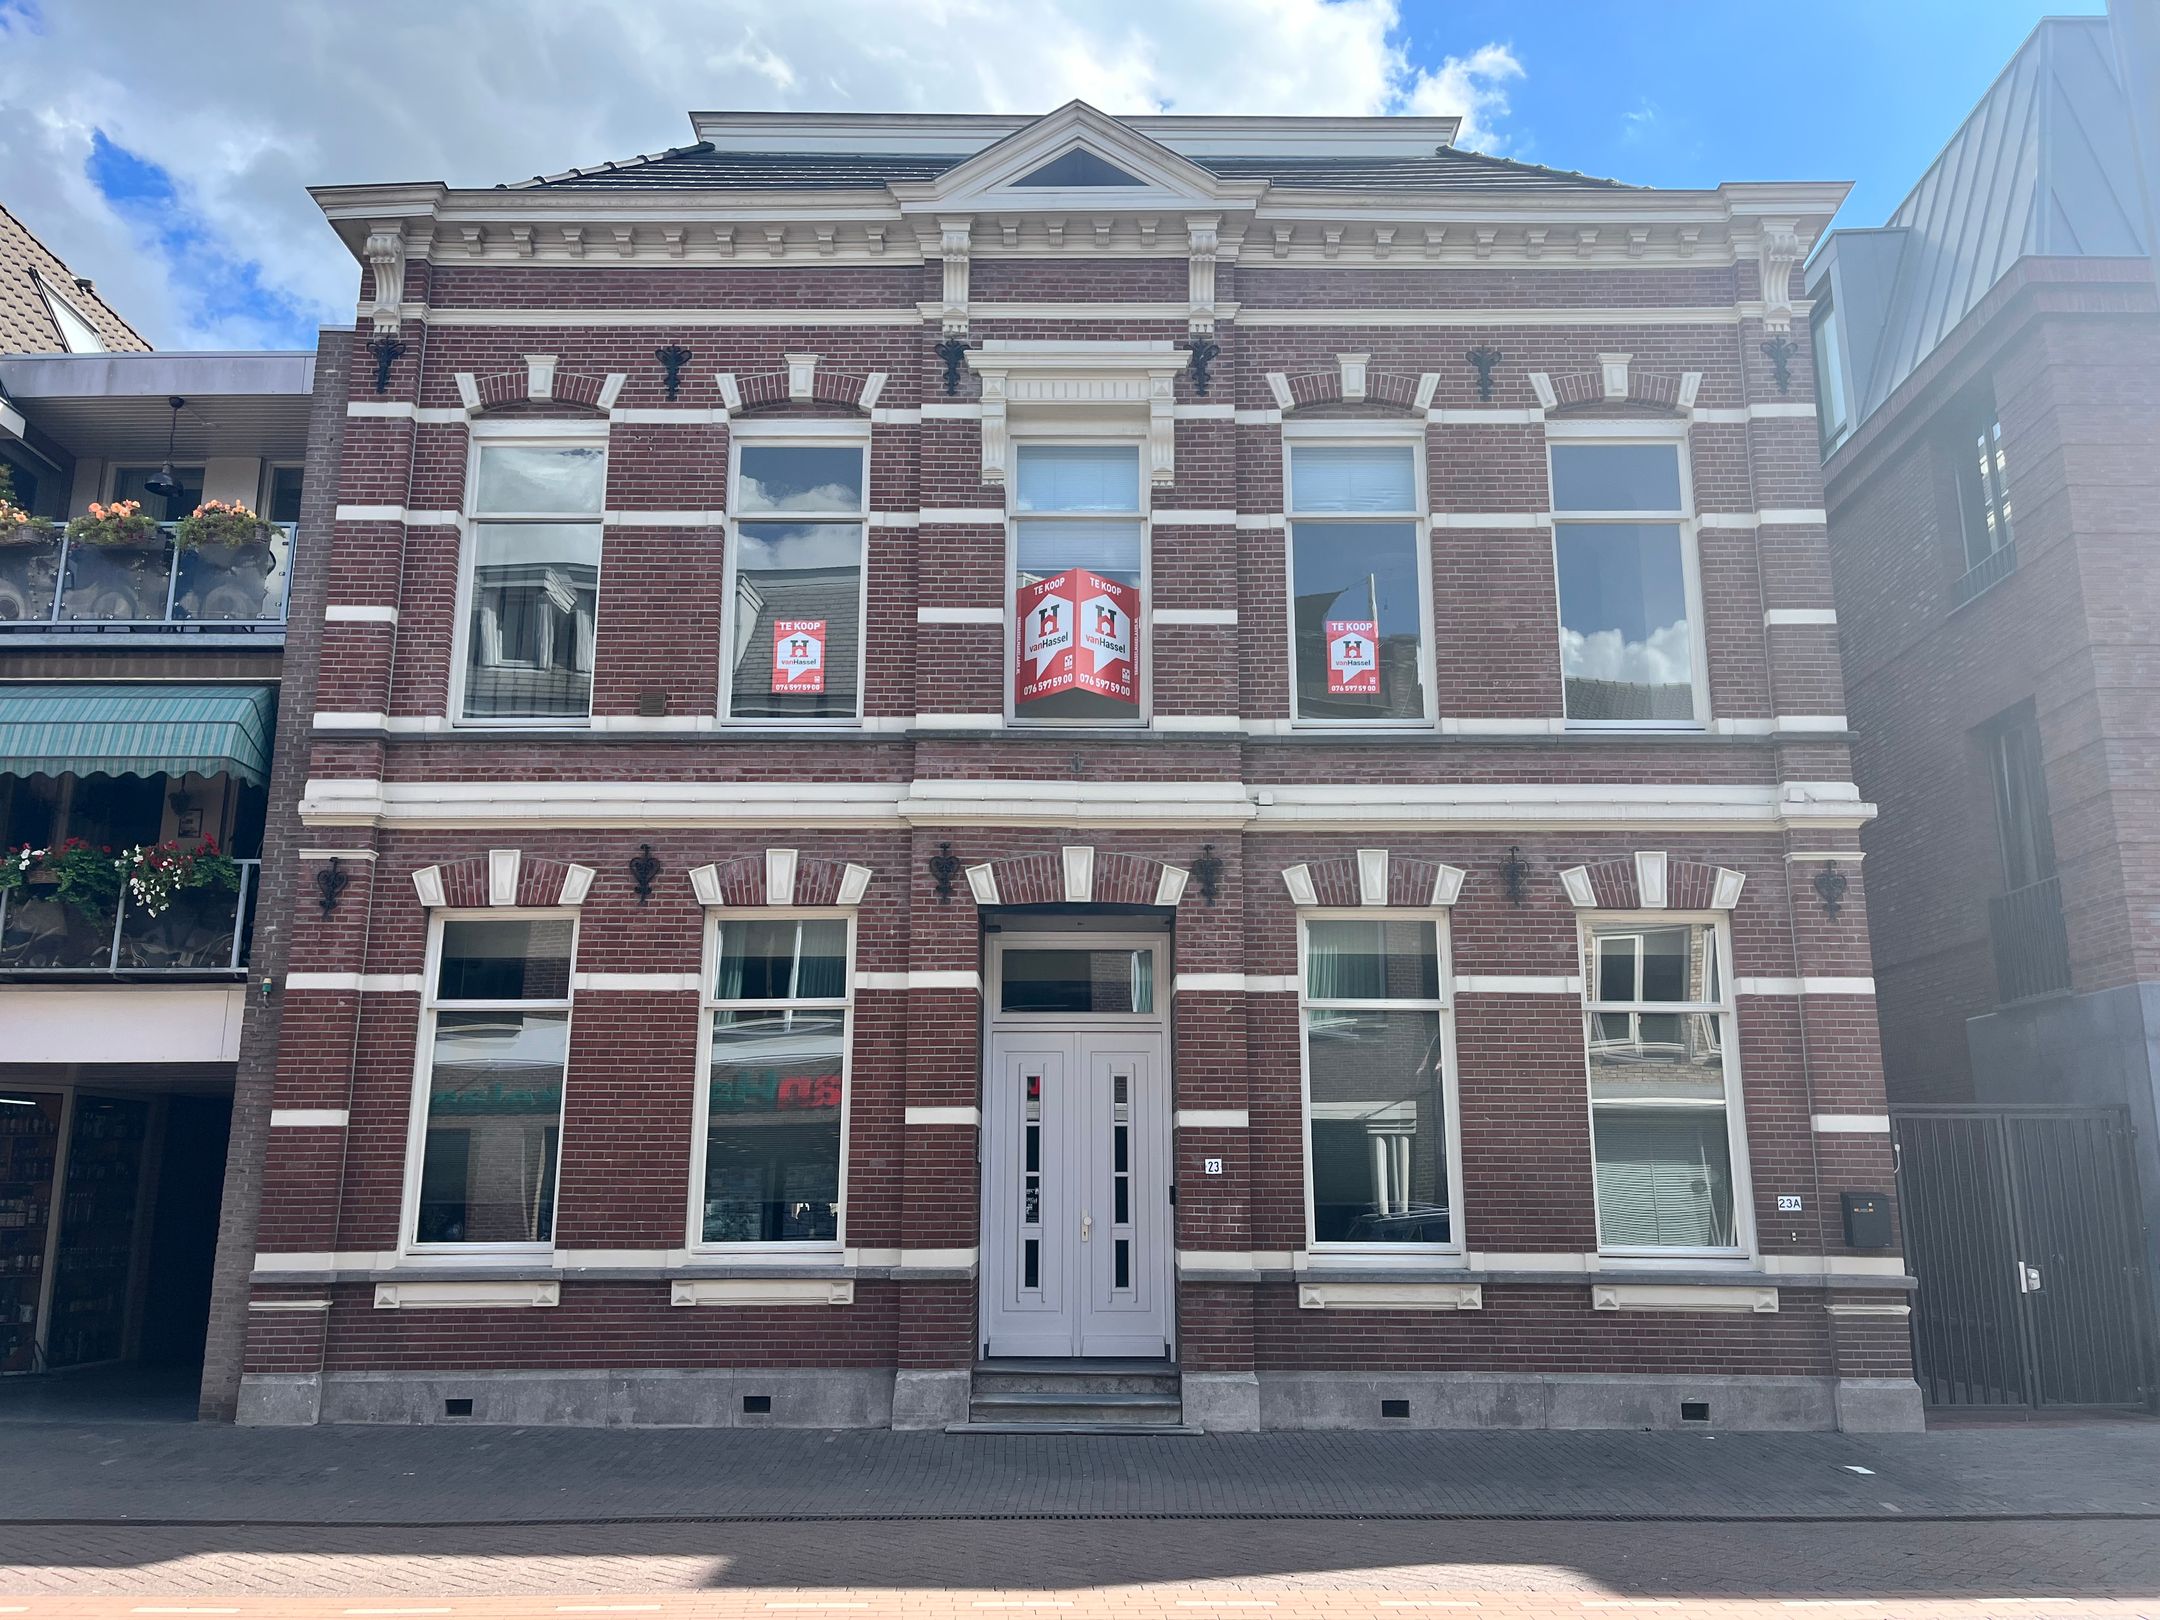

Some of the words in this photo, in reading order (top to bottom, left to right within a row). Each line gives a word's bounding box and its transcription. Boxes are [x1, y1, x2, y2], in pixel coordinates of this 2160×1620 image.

[1034, 585, 1044, 595] TE
[1044, 577, 1065, 591] KOOP
[1090, 577, 1100, 588] TE
[1100, 582, 1122, 596] KOOP
[779, 622, 792, 630] TE
[794, 622, 821, 630] KOOP
[1331, 622, 1344, 631] TE
[1346, 622, 1373, 631] KOOP
[1029, 631, 1068, 653] vanHassel
[1086, 633, 1126, 654] vanHassel
[1024, 685, 1037, 695] 076
[1038, 679, 1052, 691] 597
[1053, 676, 1062, 687] 59
[1062, 673, 1073, 684] 00
[1080, 673, 1094, 686] 076
[1095, 678, 1110, 690] 597
[1110, 683, 1120, 694] 59
[1120, 687, 1130, 697] 00
[1207, 1161, 1220, 1173] 23
[1778, 1198, 1801, 1209] 23A
